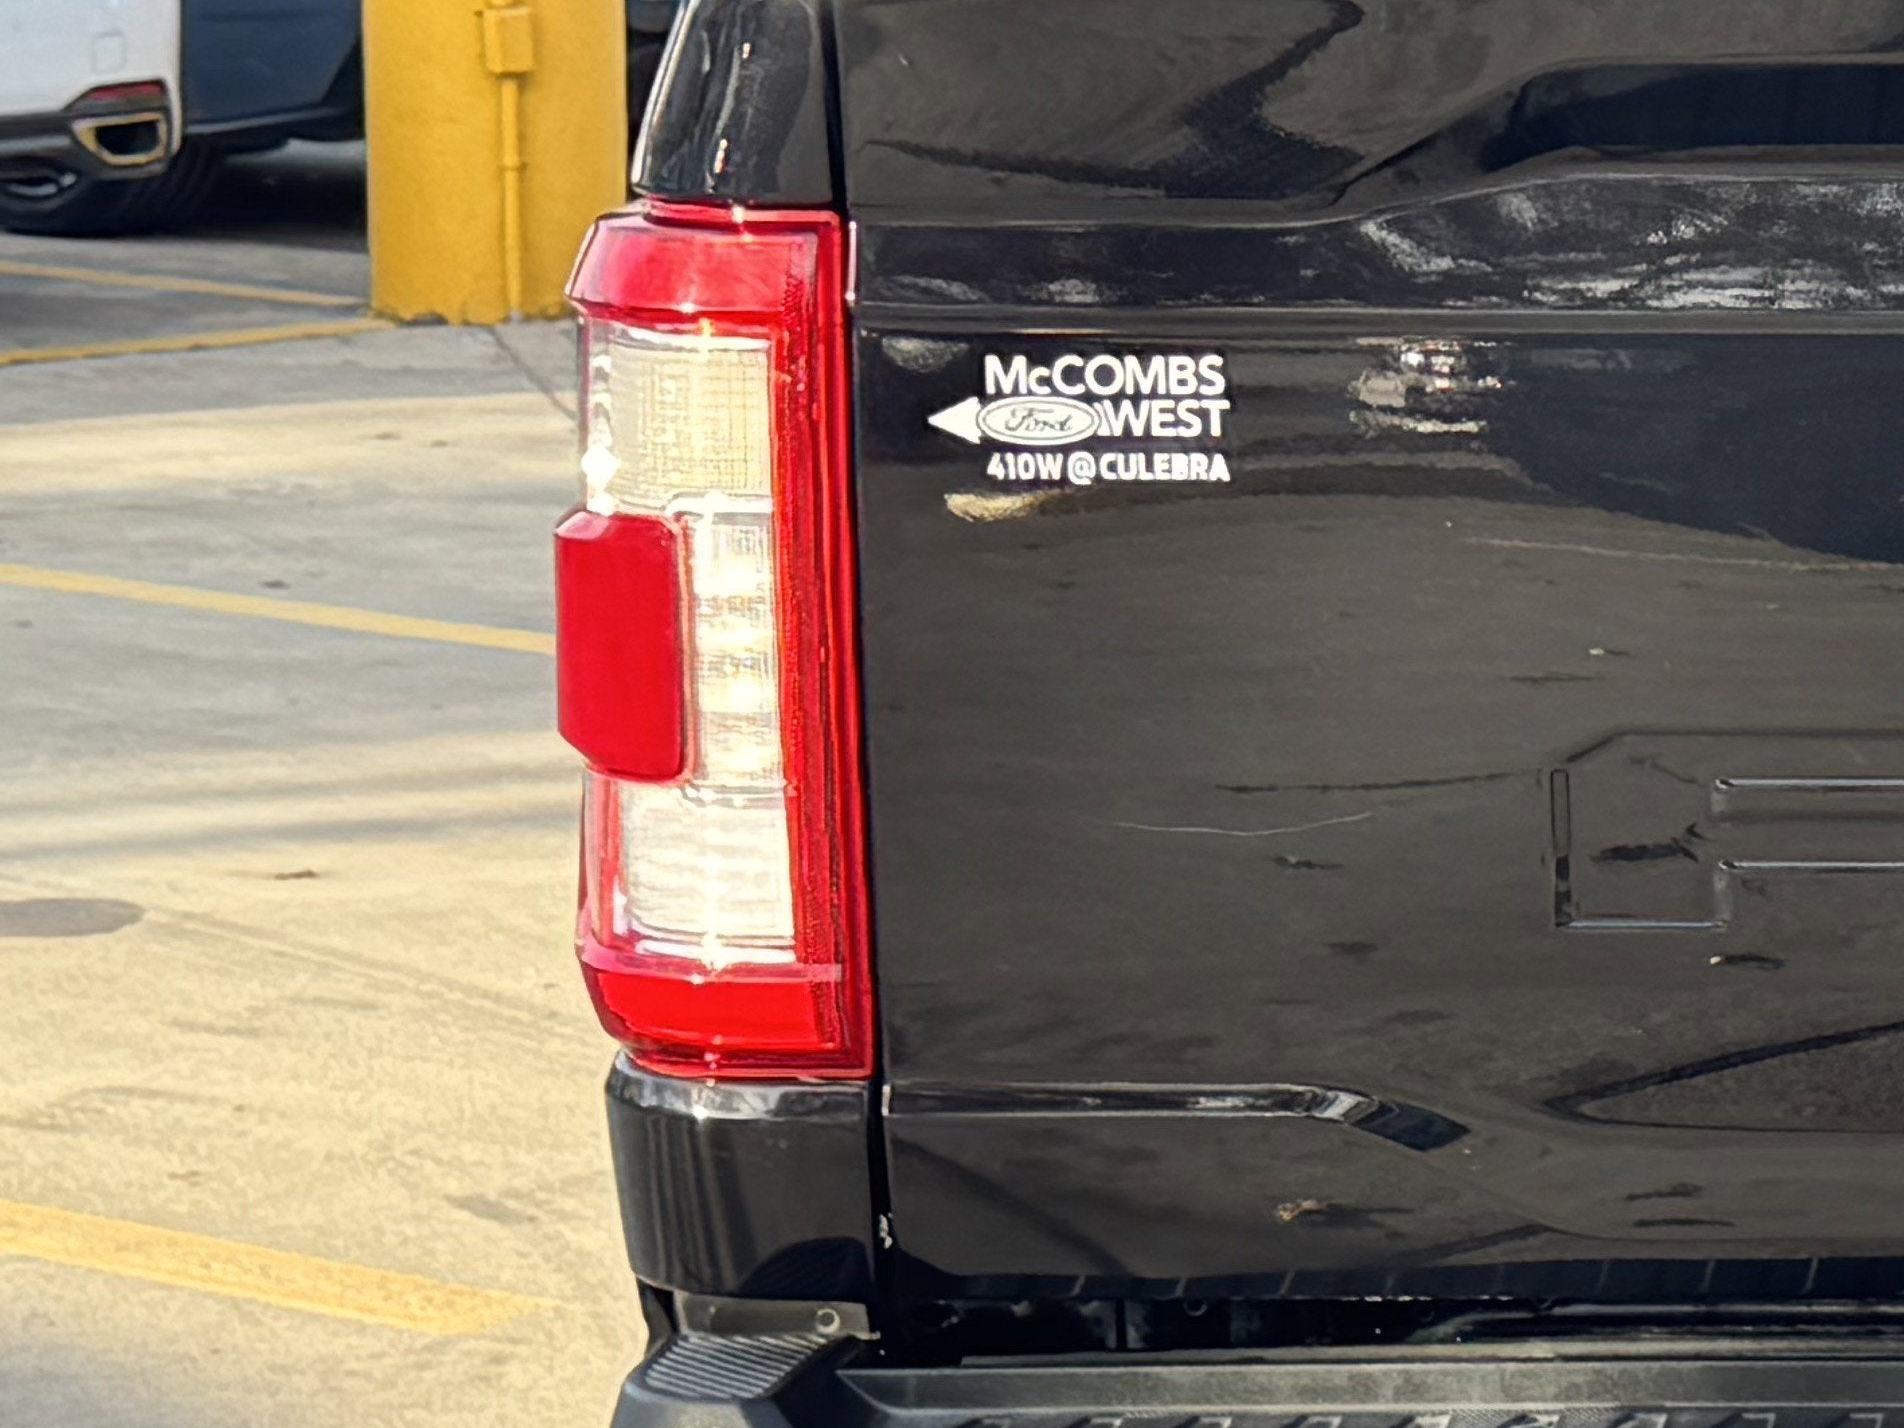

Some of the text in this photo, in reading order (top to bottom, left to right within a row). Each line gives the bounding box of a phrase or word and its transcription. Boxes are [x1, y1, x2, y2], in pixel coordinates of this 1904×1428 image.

[984, 354, 1227, 395] McCOMBS
[1095, 399, 1231, 437] WEST
[1099, 452, 1231, 482] CULEBRA
